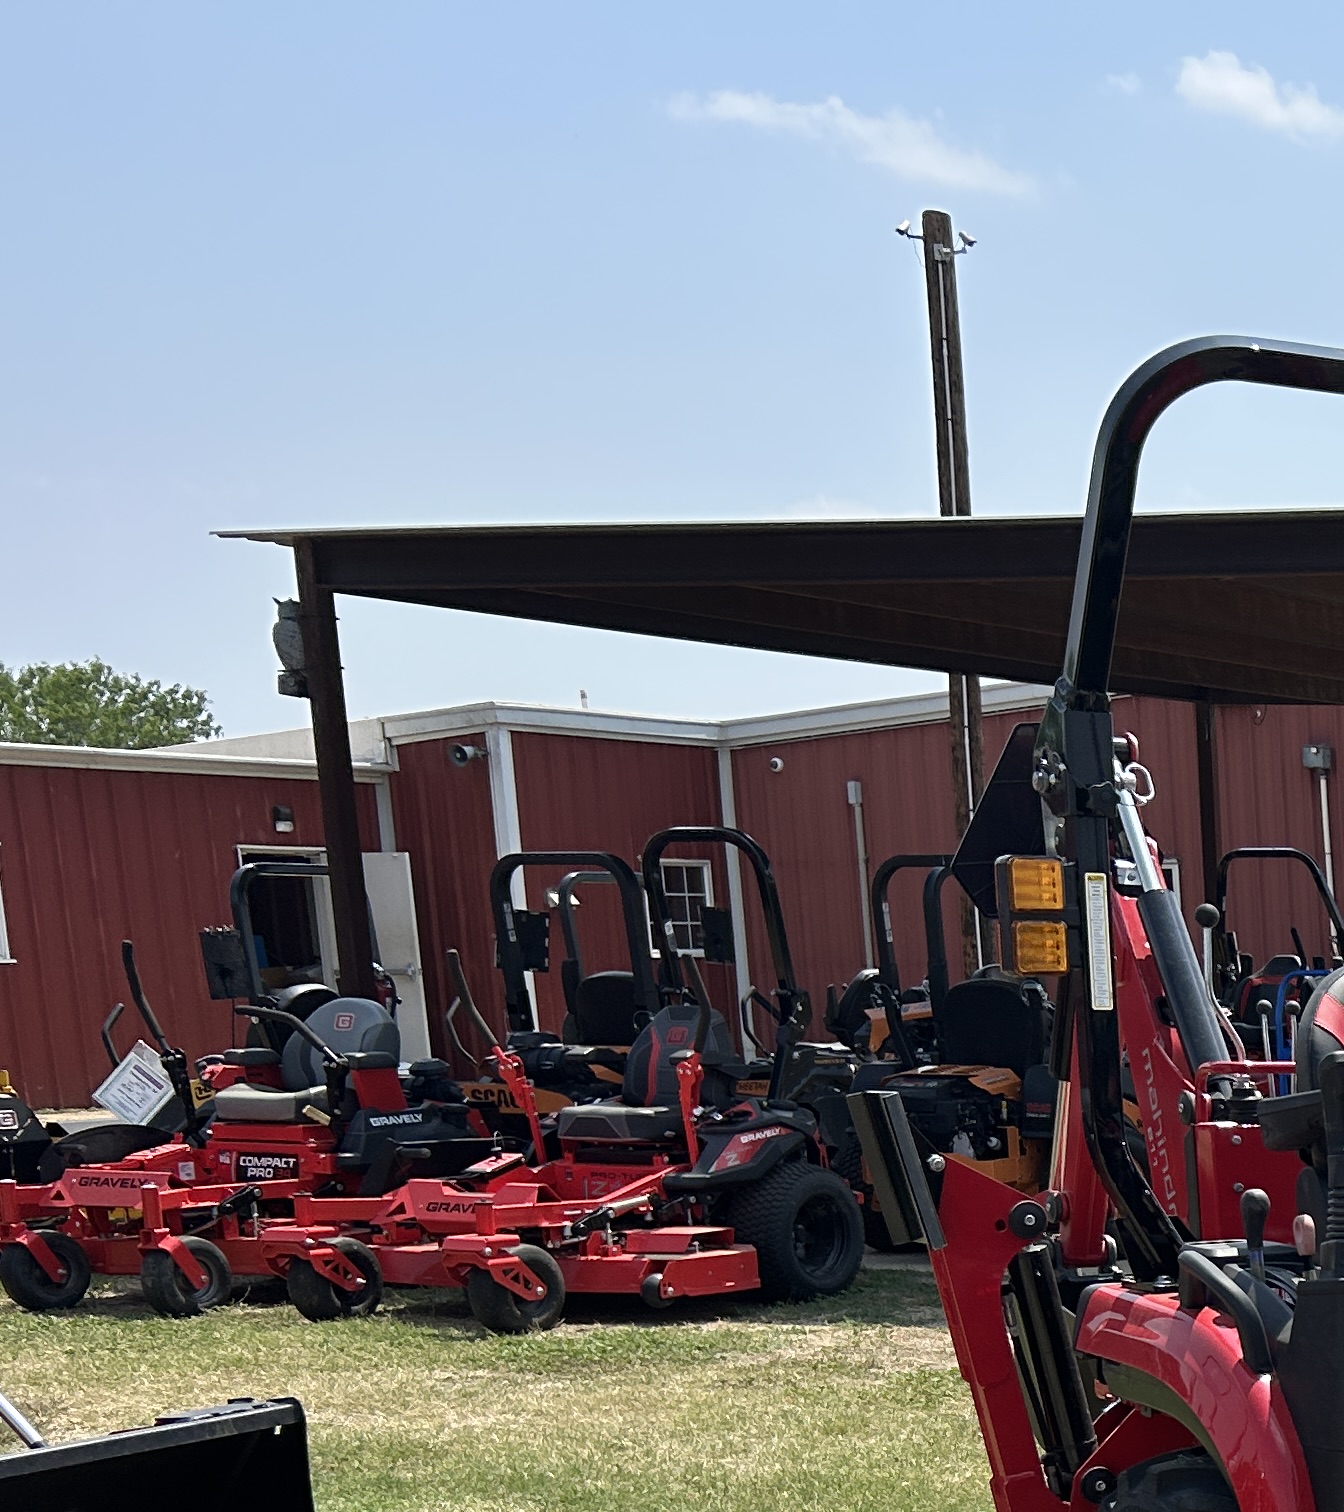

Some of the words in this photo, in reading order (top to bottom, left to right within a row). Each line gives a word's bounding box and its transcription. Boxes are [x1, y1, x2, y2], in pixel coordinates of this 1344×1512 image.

[369, 1113, 423, 1128] GRAVELY
[239, 1155, 297, 1168] COMPACT
[246, 1167, 274, 1179] PRO
[78, 1176, 148, 1189] GRAVELY
